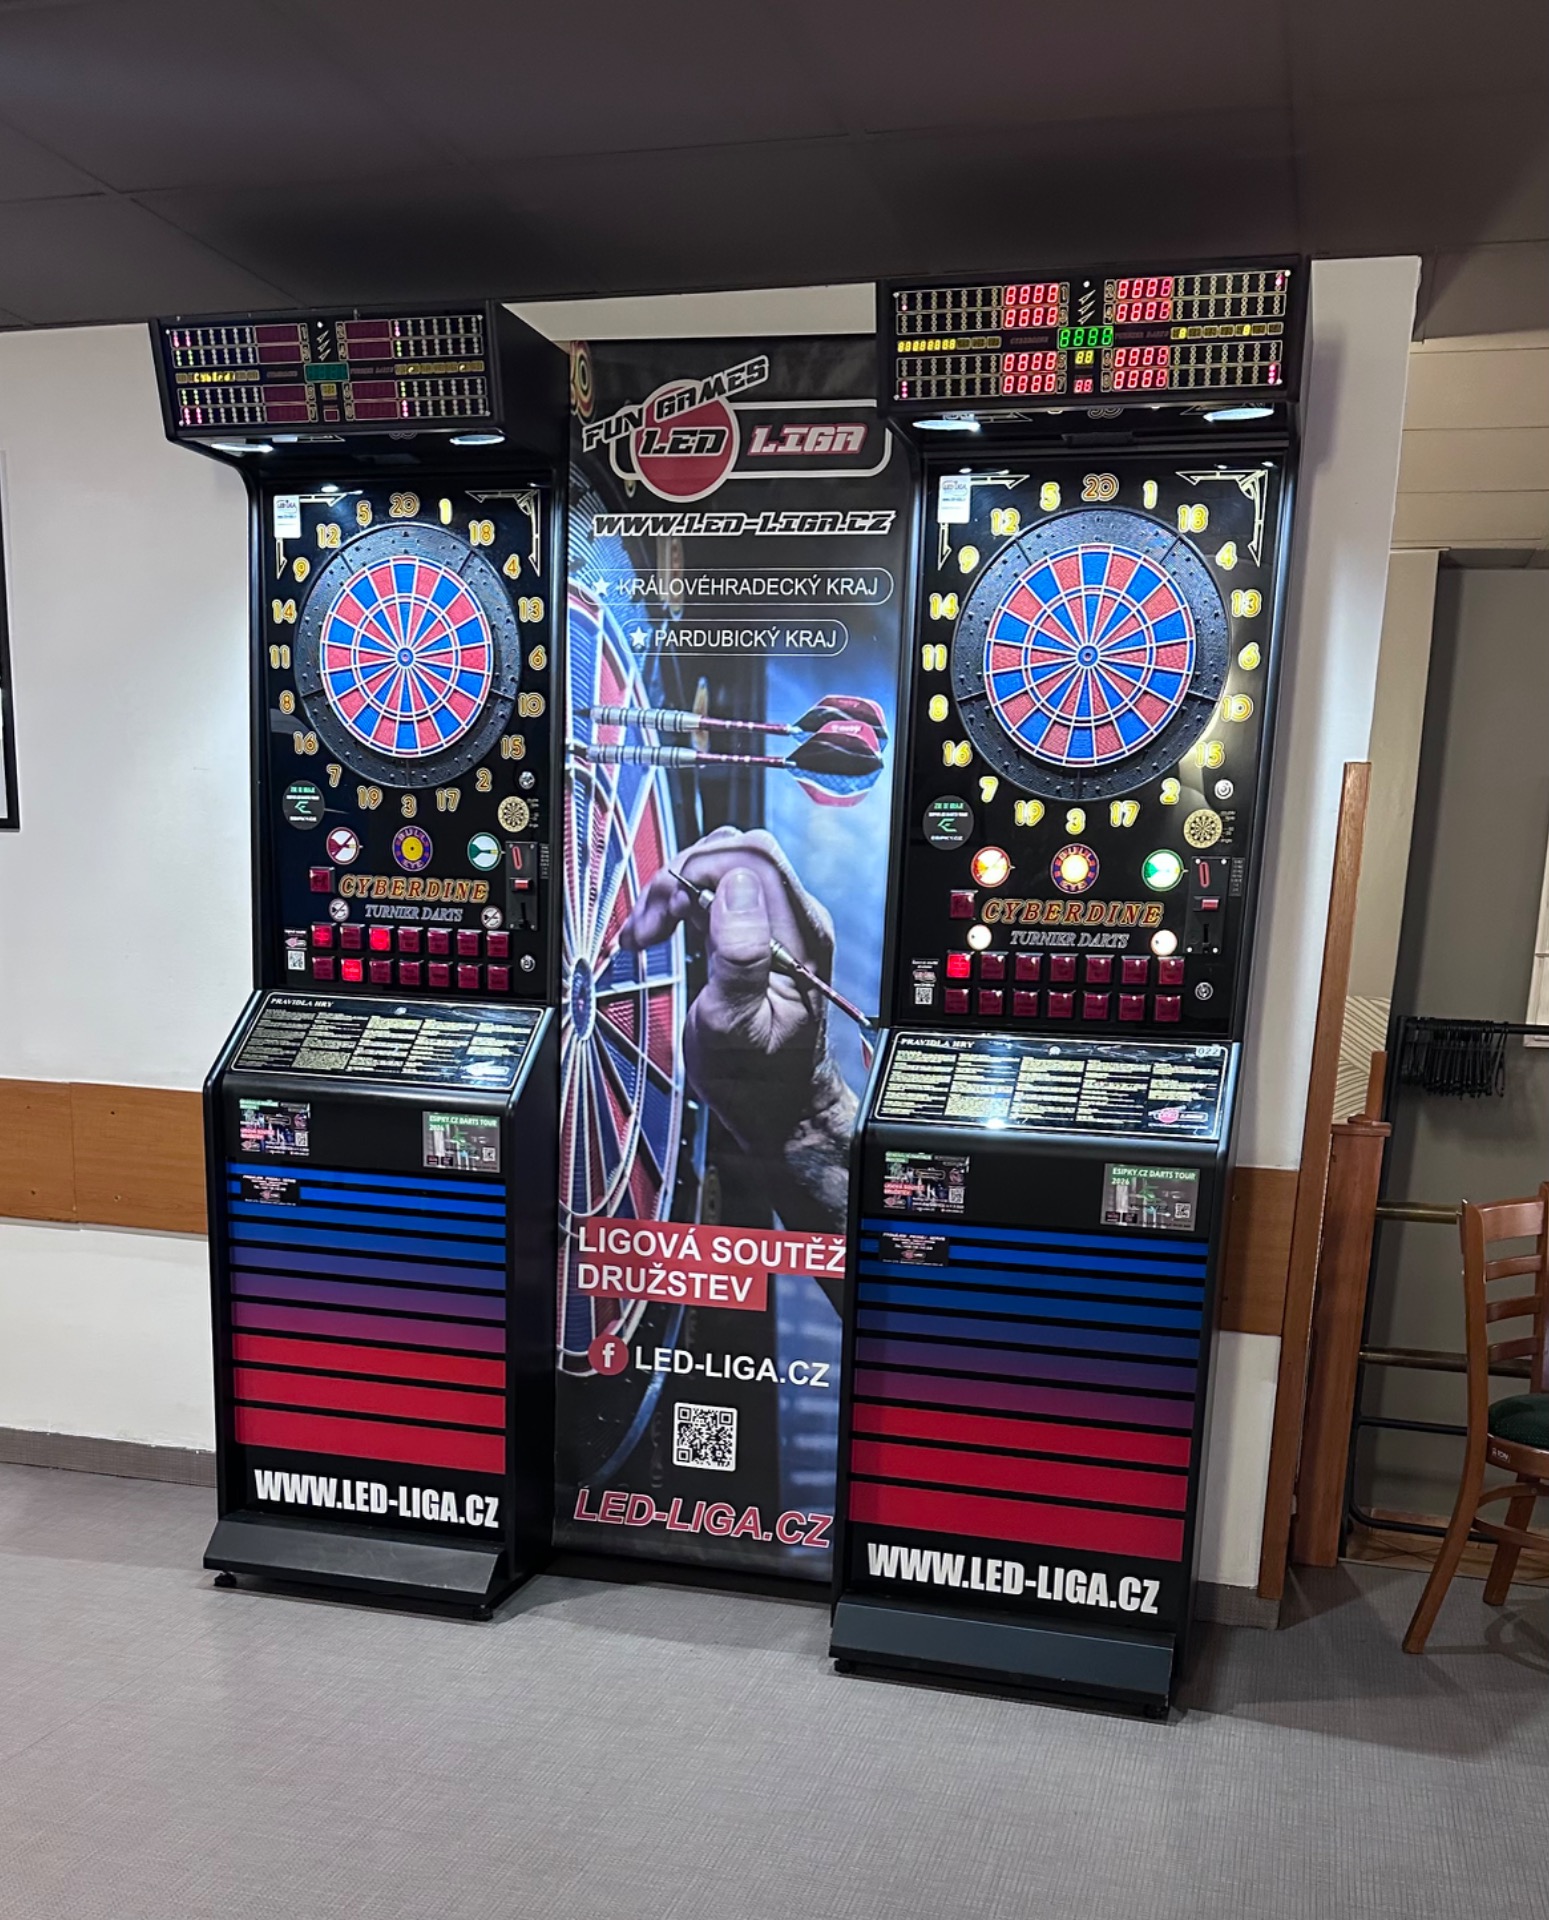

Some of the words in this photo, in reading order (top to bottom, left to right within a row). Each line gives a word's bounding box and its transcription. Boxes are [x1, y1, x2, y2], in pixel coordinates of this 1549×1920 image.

[582, 406, 646, 452] FUN
[654, 355, 769, 422] GAMES
[638, 427, 729, 457] LED
[748, 423, 868, 456] LIGA
[1040, 482, 1061, 511] 5
[1082, 473, 1119, 501] 20
[1143, 480, 1158, 509] 1
[356, 500, 372, 526] 5
[389, 492, 420, 518] 20
[439, 499, 453, 525] 1
[592, 510, 896, 537] WWW.LED-LIGA.CZ
[990, 508, 1020, 536] 12
[1178, 504, 1209, 533] 18
[316, 523, 341, 548] 12
[469, 520, 495, 545] 18
[503, 554, 521, 579] 4
[958, 546, 979, 573] 9
[1215, 541, 1238, 570] 4
[293, 557, 310, 582] 9
[619, 572, 821, 596] KRÁLOVÉHRADECKÝ
[826, 577, 878, 596] KRAJ
[272, 599, 297, 624] 14
[518, 597, 544, 622] 13
[929, 593, 959, 620] 14
[1231, 589, 1262, 617] 13
[654, 626, 780, 648] PARDUBICKÝ
[785, 628, 836, 648] KRAJ
[269, 645, 291, 669] 11
[528, 645, 547, 670] 6
[922, 644, 947, 671] 11
[1238, 642, 1261, 670] 6
[279, 690, 295, 714] 8
[517, 692, 545, 717] 10
[928, 694, 948, 721] 8
[1221, 694, 1254, 721] 10
[294, 731, 319, 755] 16
[501, 735, 526, 760] 15
[943, 740, 972, 767] 16
[1195, 741, 1226, 768] 15
[326, 764, 342, 787] 7
[475, 767, 492, 792] 2
[357, 785, 383, 810] 19
[436, 787, 461, 812] 17
[979, 776, 999, 802] 7
[1160, 778, 1180, 805] 2
[401, 794, 417, 817] 3
[1014, 800, 1045, 827] 19
[1110, 800, 1140, 827] 17
[1065, 808, 1086, 835] 3
[1058, 846, 1092, 861] BULL
[339, 874, 489, 903] CYBERDINE
[421, 907, 463, 922] DARTS
[982, 898, 1164, 928] CYBERDINE
[1077, 932, 1130, 949] DARTS
[271, 998, 313, 1007] PRAVIDLA
[314, 1000, 335, 1008] HRY
[900, 1038, 950, 1047] PRAVIDLA
[952, 1040, 975, 1049] HRY
[459, 1117, 479, 1125] DARTS
[480, 1119, 498, 1127] TOUR
[1112, 1167, 1148, 1177] ESIPKY.CZ
[1149, 1169, 1174, 1179] DARTS
[1175, 1172, 1196, 1180] TOUR
[578, 1226, 702, 1261] LIGOVÁ
[711, 1236, 846, 1273] SOUTĚŽ
[578, 1263, 752, 1303] DRUŽSTEV
[635, 1346, 830, 1387] LED-LIGA.CZ
[254, 1469, 499, 1528] WWW.LED-LIGA.CZ
[573, 1489, 834, 1548] LED-LIGA.CZ
[867, 1542, 1160, 1614] WWW.LED-LIGA.CZ
